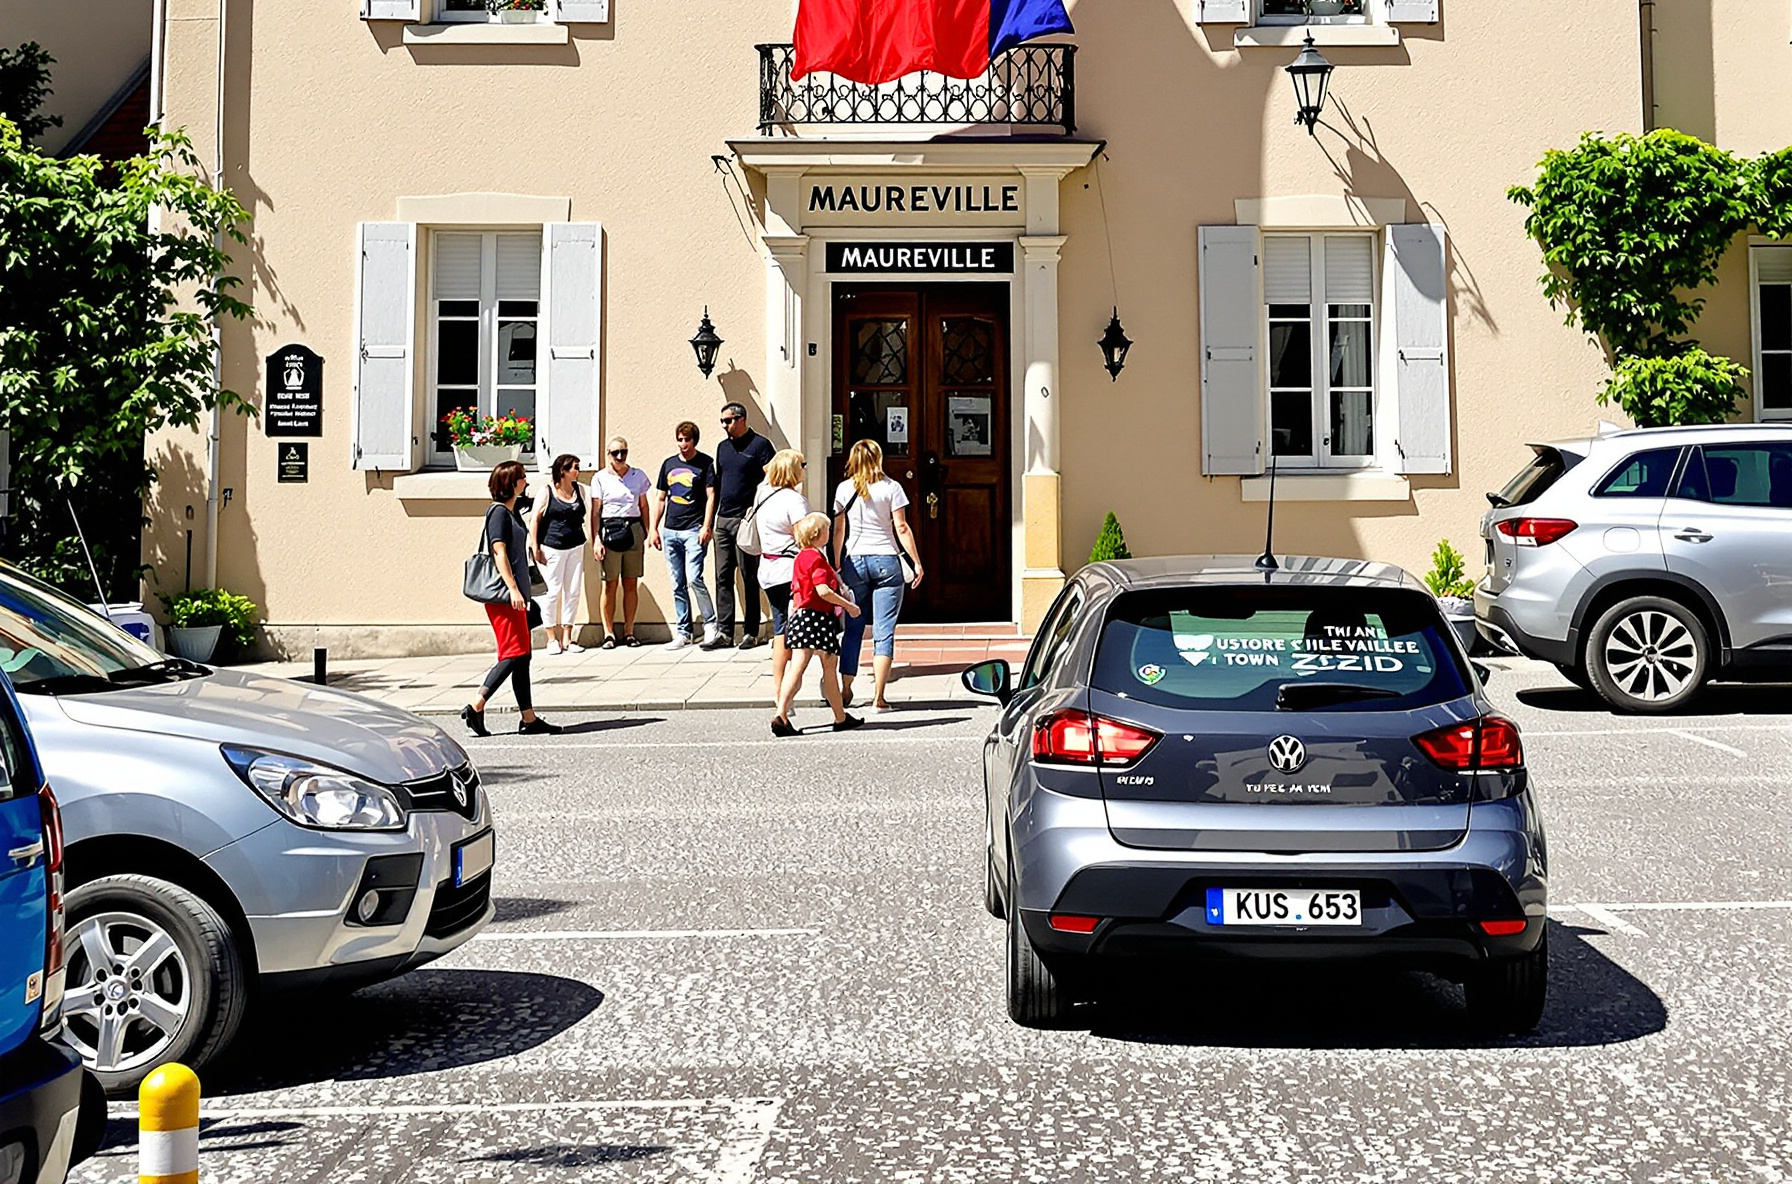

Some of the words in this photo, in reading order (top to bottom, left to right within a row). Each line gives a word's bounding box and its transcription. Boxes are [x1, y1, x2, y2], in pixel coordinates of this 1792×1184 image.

[808, 185, 1019, 212] MAUREVILLE
[841, 247, 995, 268] MAUREVILLE
[1223, 653, 1279, 666] TOWN
[1236, 892, 1289, 920] KUS
[1308, 893, 1358, 920] 653
